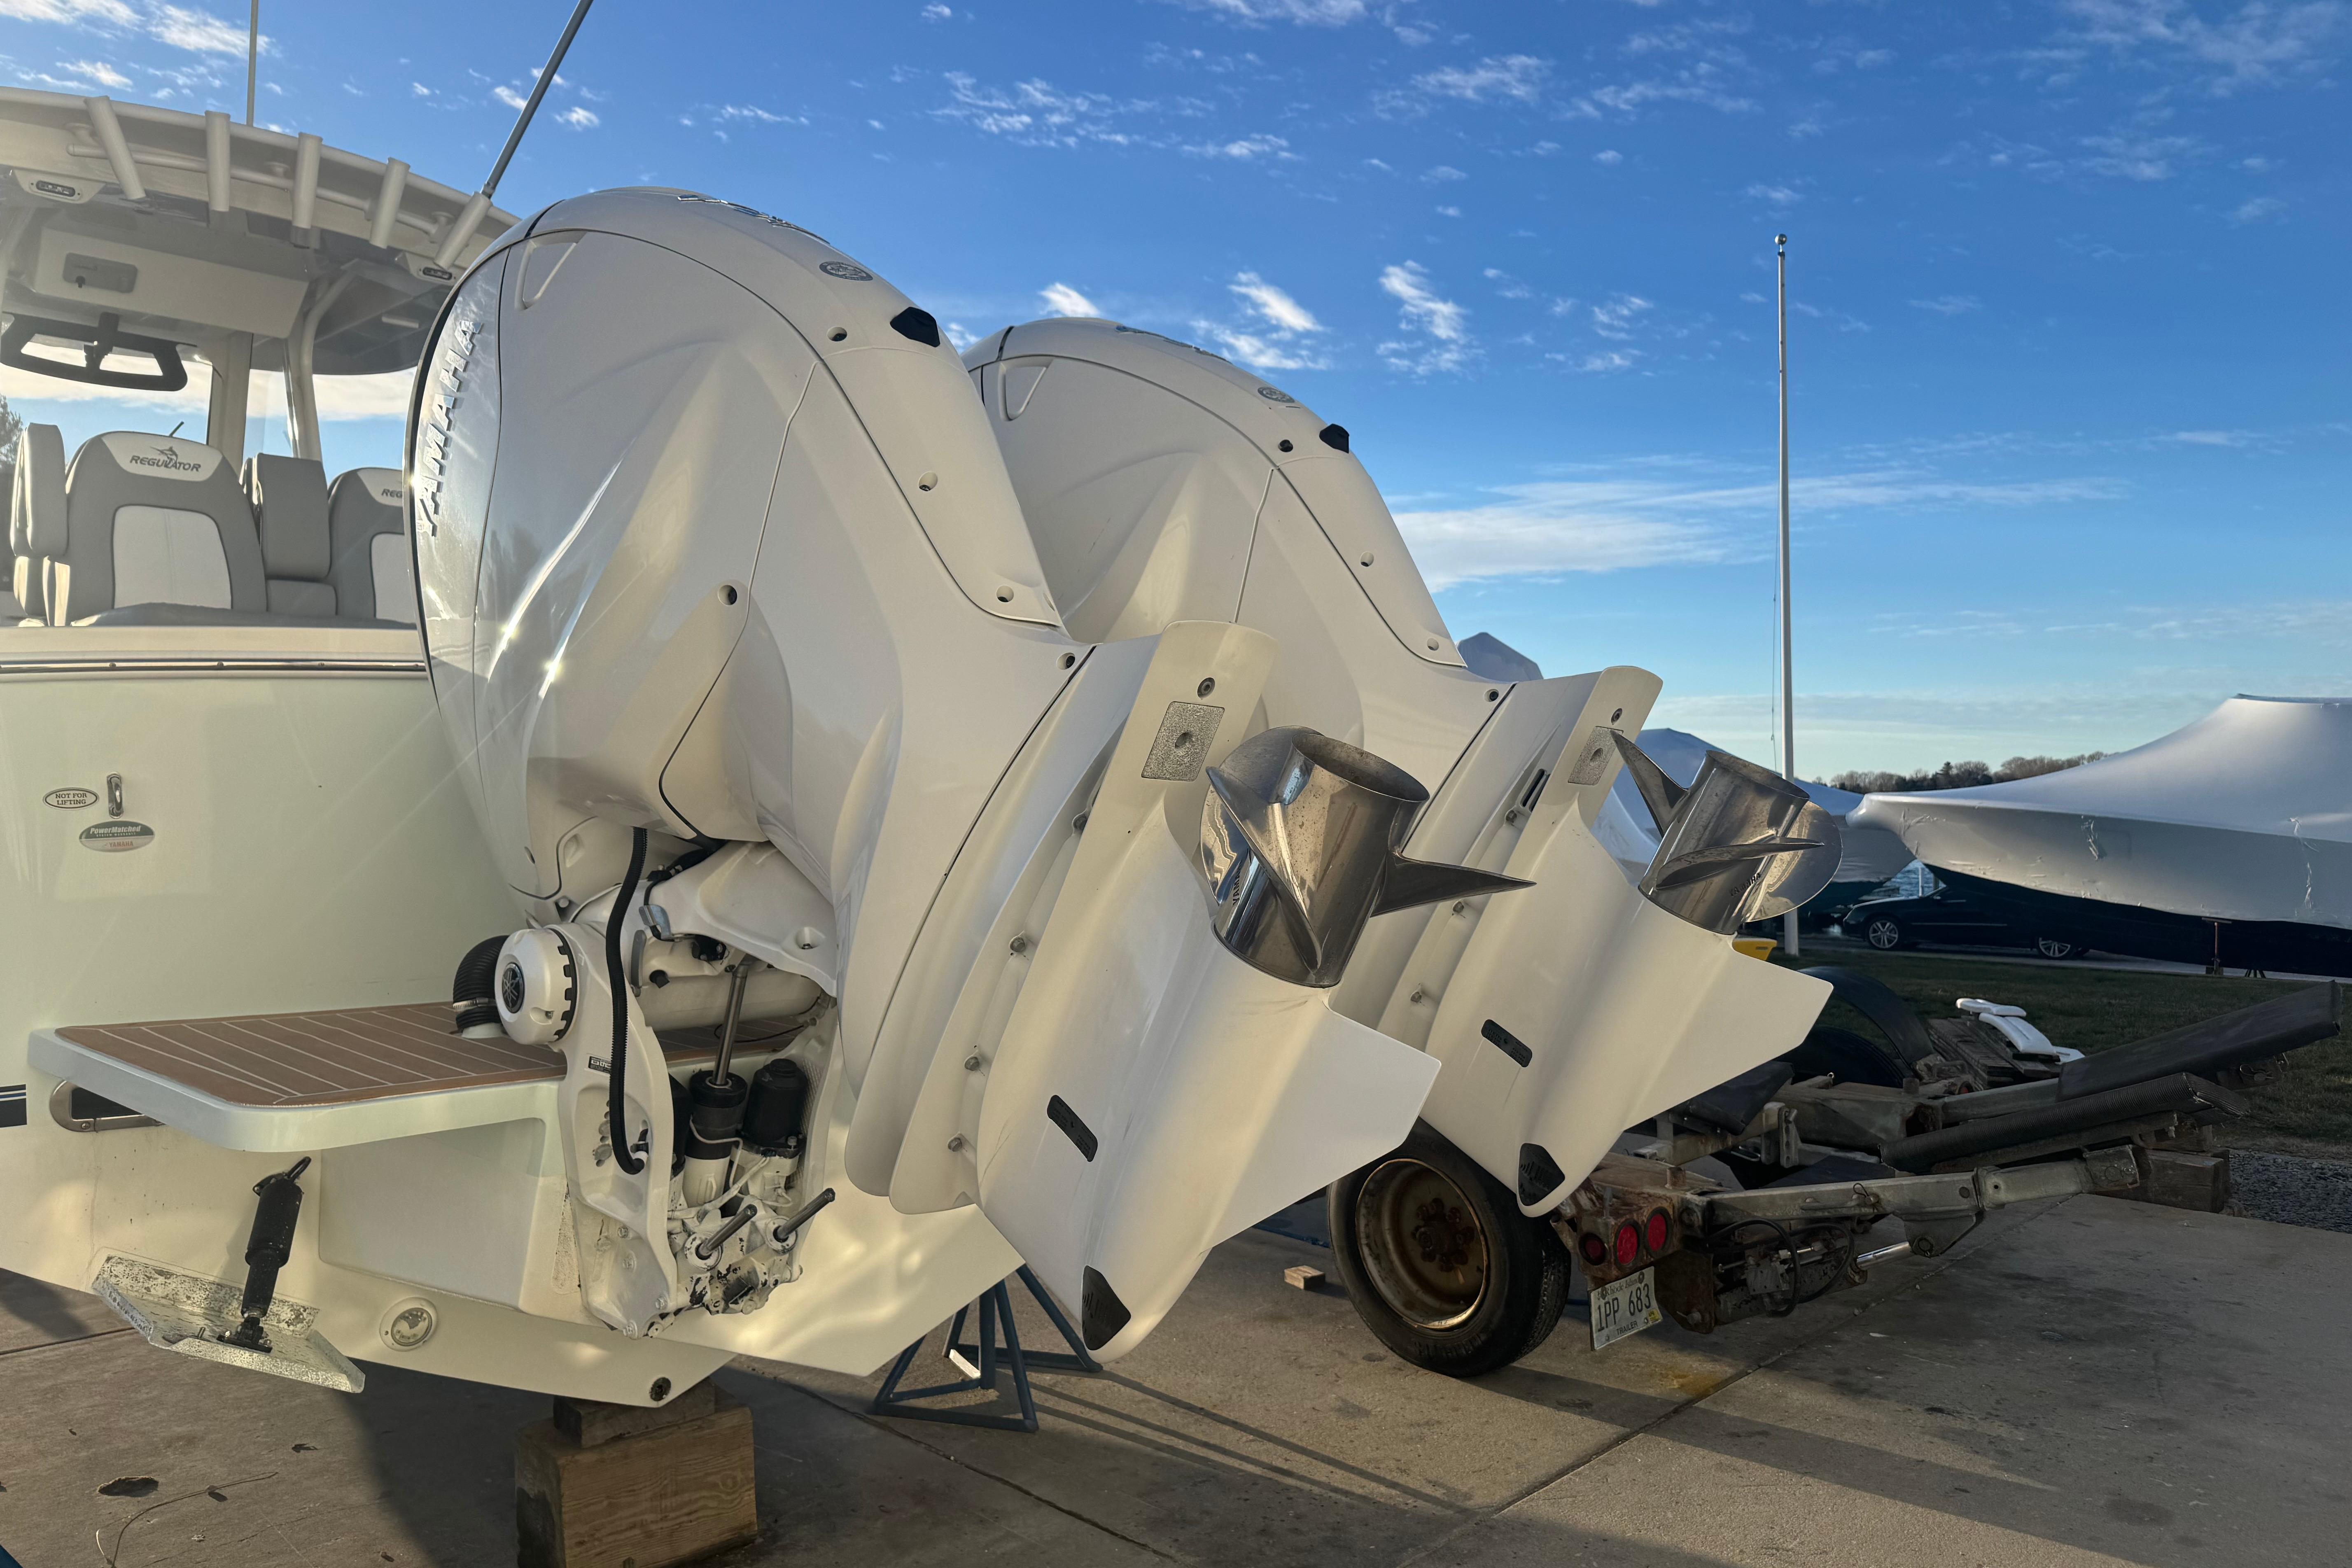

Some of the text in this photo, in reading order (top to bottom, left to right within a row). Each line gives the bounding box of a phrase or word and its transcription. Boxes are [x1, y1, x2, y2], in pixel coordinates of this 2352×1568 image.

[417, 320, 483, 537] YAMAHA
[130, 455, 201, 472] REGULATOR
[90, 825, 141, 834] PowerMatched
[1624, 1278, 1639, 1289] Islan
[1597, 1283, 1651, 1332] 1PP 683
[1617, 1321, 1638, 1335] TRAILER
